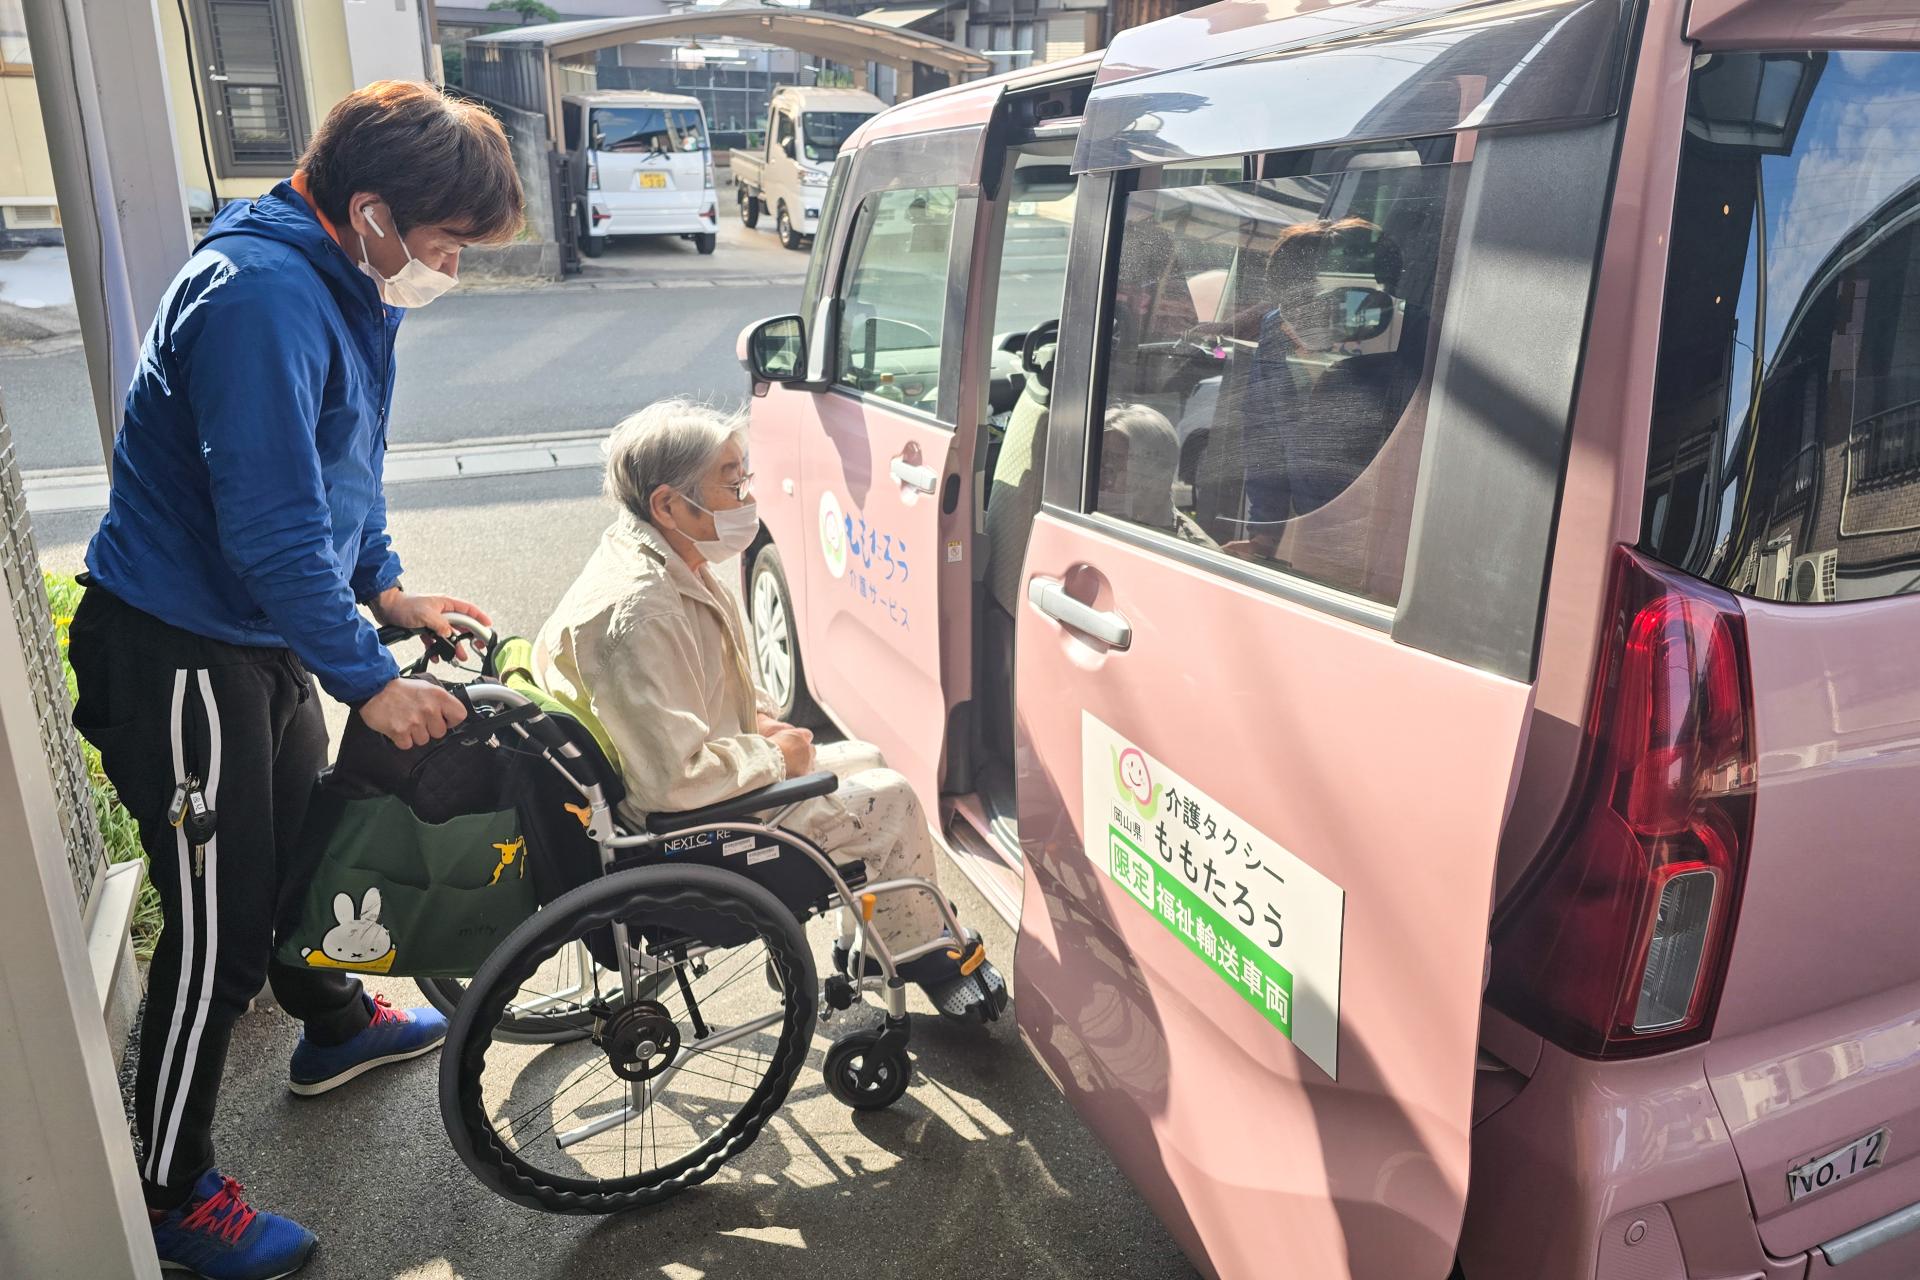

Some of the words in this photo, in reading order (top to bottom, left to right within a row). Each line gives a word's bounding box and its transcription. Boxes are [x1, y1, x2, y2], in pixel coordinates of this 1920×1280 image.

[1113, 805, 1143, 842] 岡山県
[1113, 841, 1151, 901] 限定
[1165, 787, 1285, 884] 介護タクシー
[1154, 820, 1284, 948] ももたろう
[1155, 881, 1290, 1025] 福祉輸送車両
